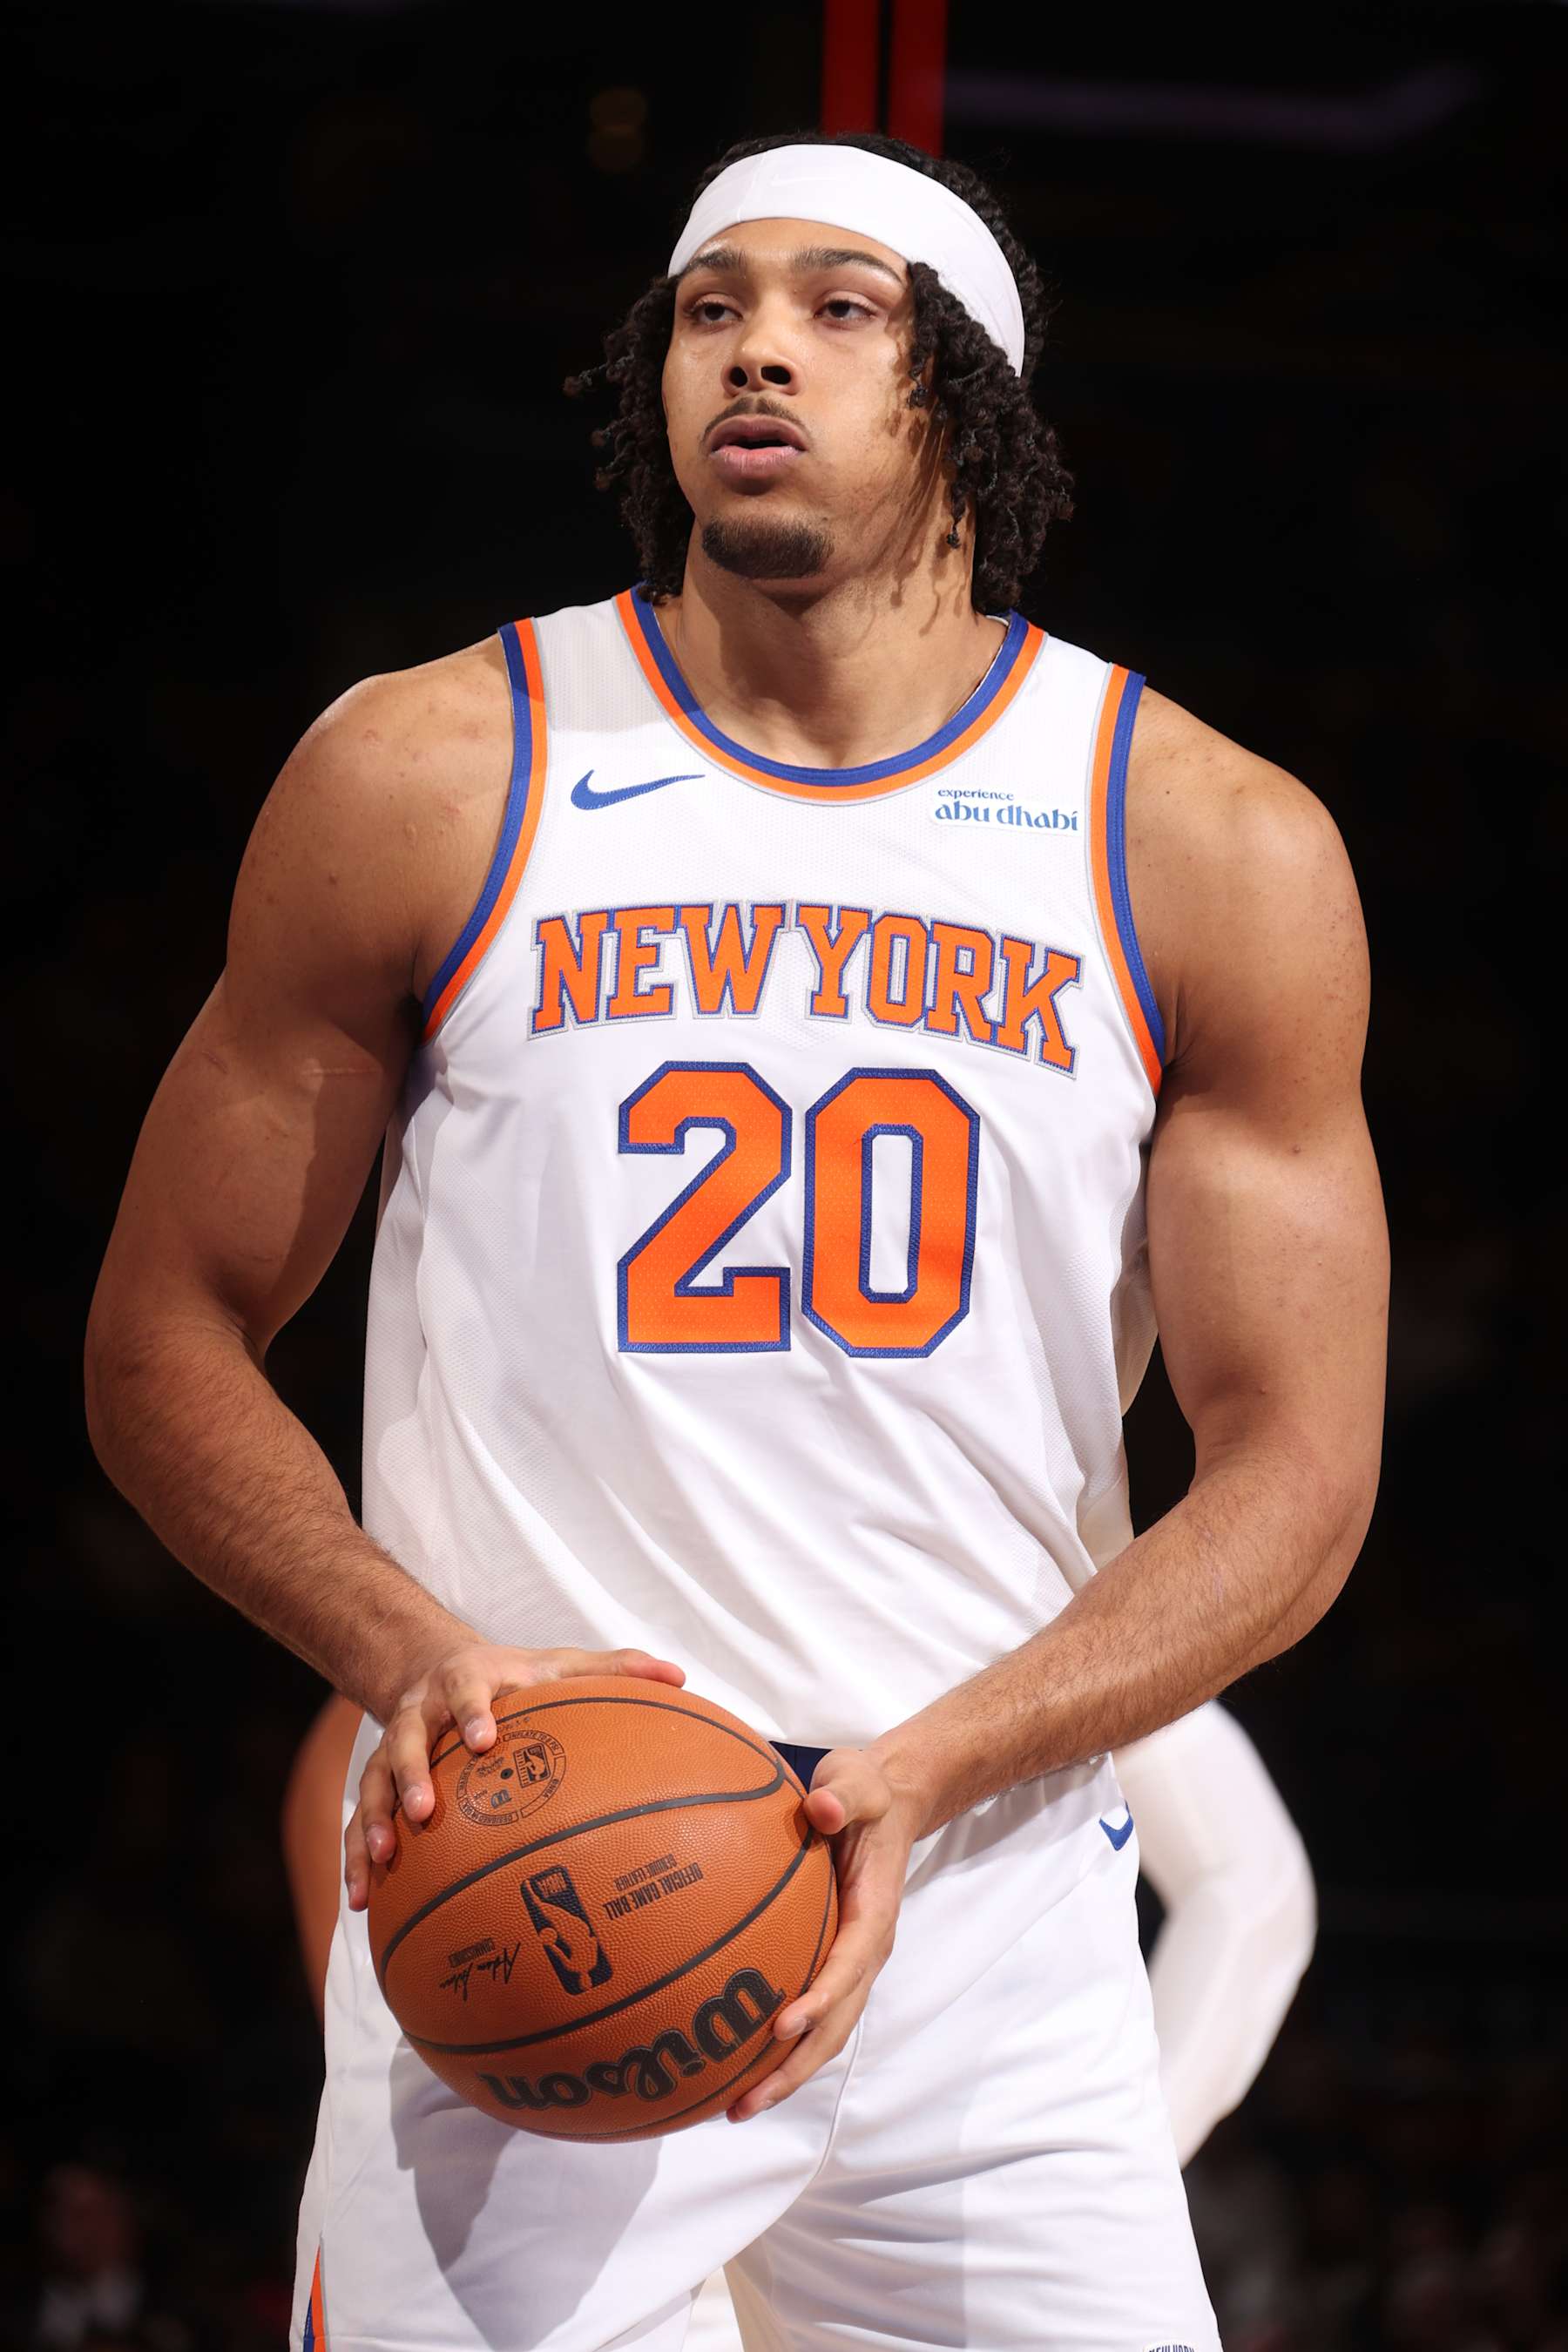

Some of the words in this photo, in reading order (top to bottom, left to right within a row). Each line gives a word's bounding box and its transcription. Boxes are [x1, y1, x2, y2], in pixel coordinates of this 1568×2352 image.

[938, 788, 1014, 801] experience
[935, 800, 990, 823] abu
[526, 900, 789, 1040] NEW
[789, 899, 1085, 1080] YORK
[618, 1060, 981, 1358] 20
[613, 1868, 647, 1892] LEATHER
[657, 1862, 704, 1895] OFFICIAL
[602, 1895, 632, 1920] BALL
[628, 1882, 661, 1909] GAME
[476, 1967, 787, 2111] Wilson
